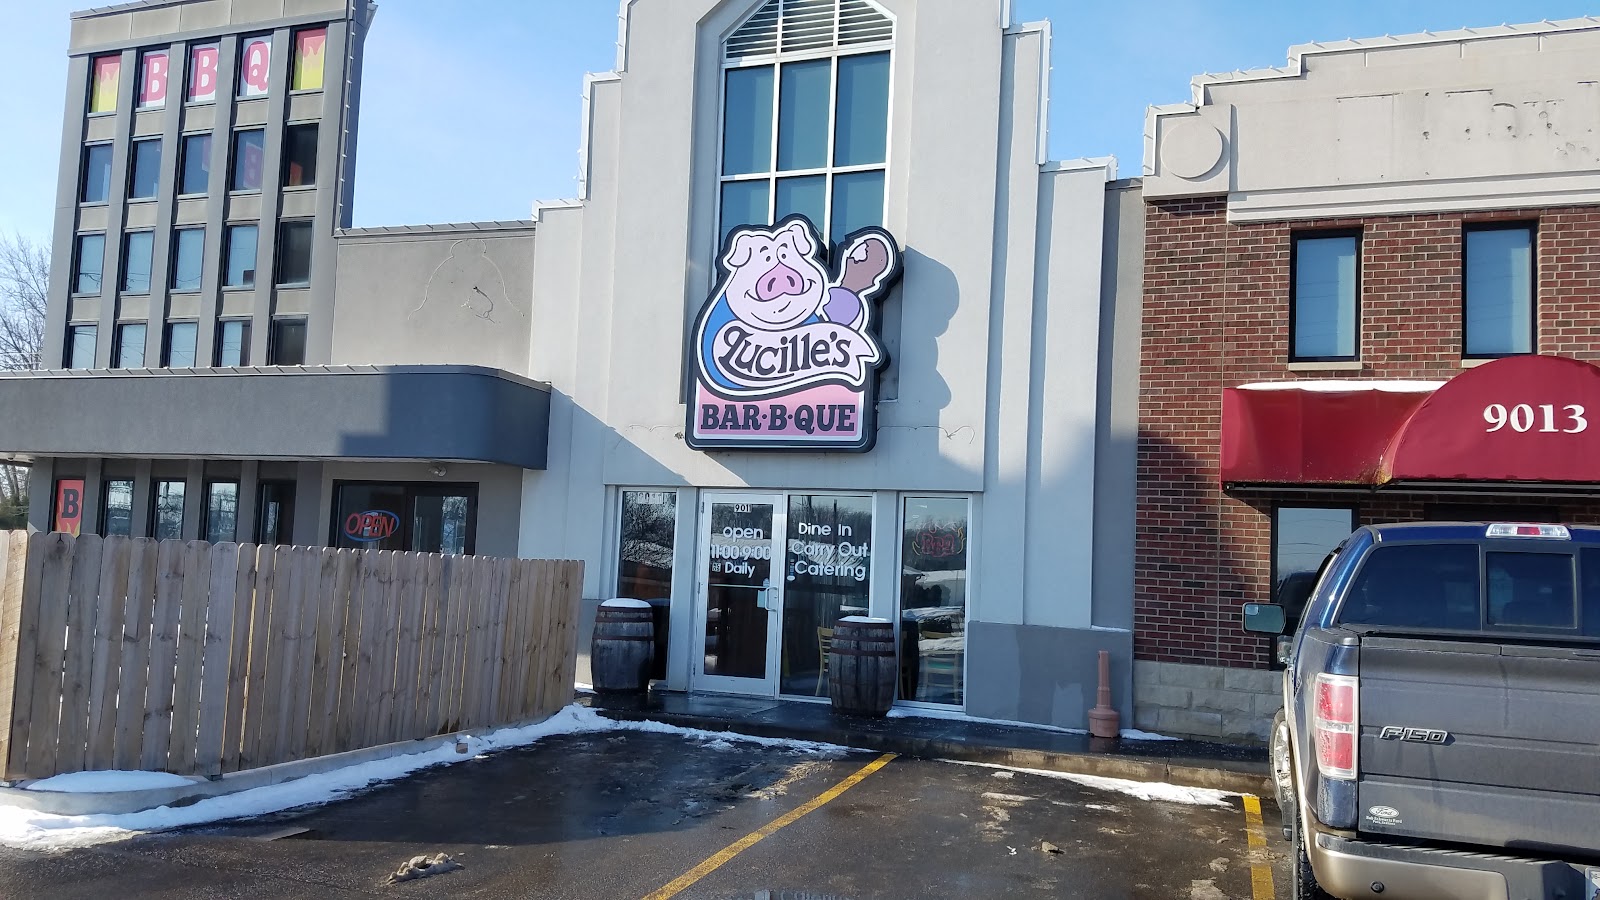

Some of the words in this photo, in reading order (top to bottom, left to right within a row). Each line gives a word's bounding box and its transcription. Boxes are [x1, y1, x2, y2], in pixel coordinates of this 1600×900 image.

[718, 325, 852, 382] Lucille's
[1483, 403, 1588, 434] 9013
[61, 488, 80, 519] B
[345, 512, 395, 538] OPEN
[723, 526, 764, 543] open
[798, 522, 832, 536] Dine
[838, 523, 852, 537] In
[791, 541, 836, 560] Carry
[838, 541, 869, 558] Out
[724, 561, 756, 579] Daily
[794, 560, 866, 582] Catering
